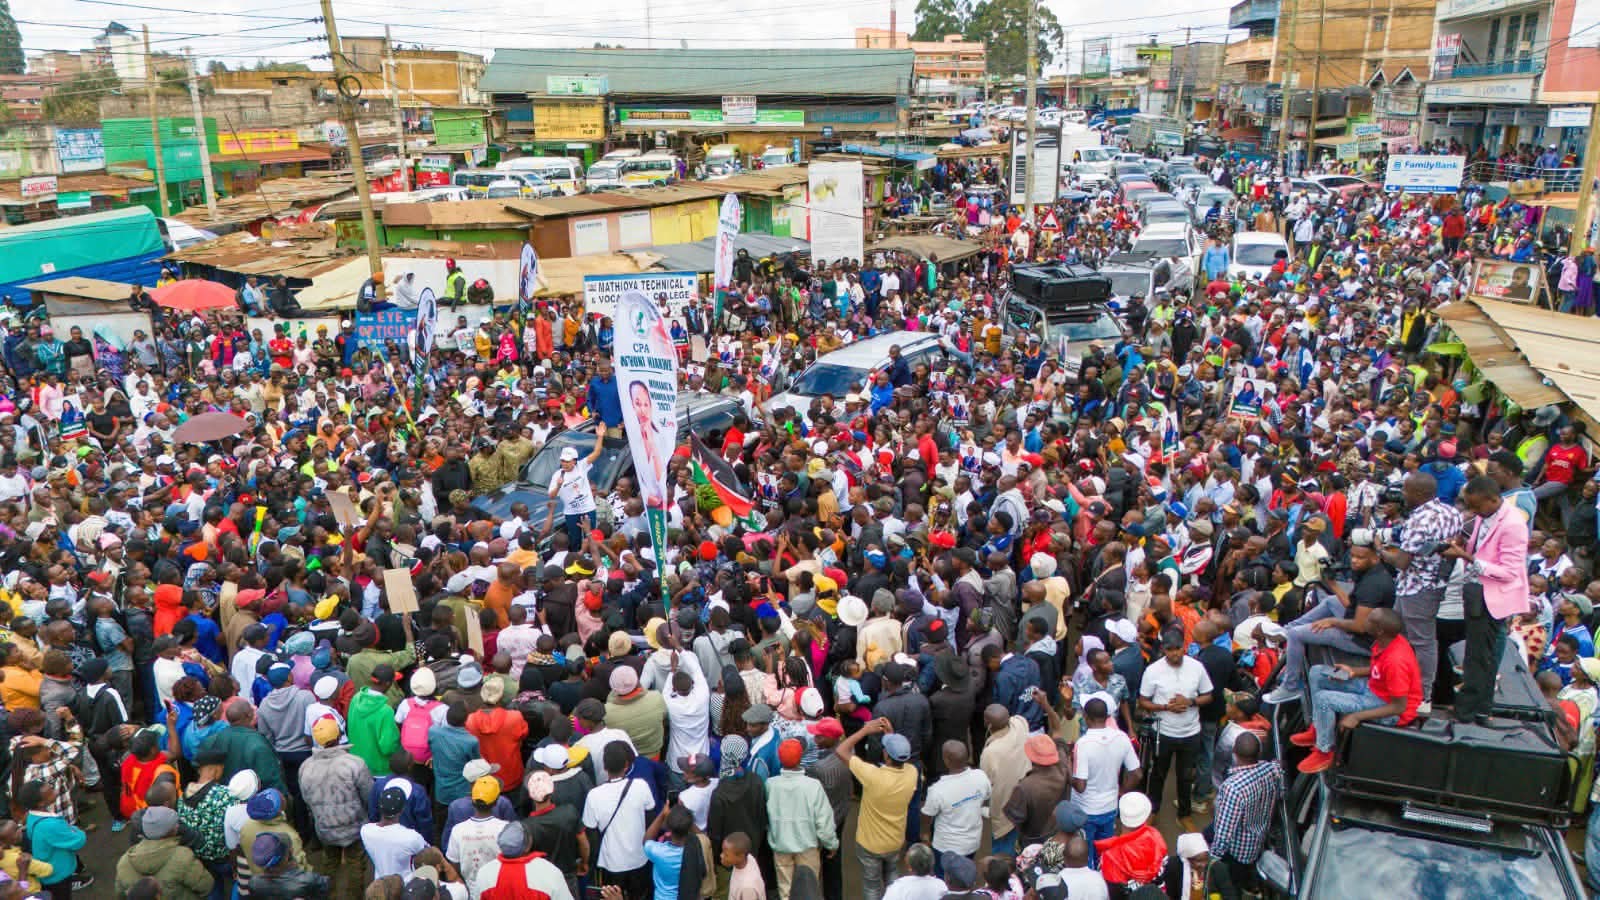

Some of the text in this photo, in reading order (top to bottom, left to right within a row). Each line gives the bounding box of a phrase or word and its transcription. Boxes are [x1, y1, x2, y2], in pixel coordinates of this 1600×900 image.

[641, 279, 684, 290] TECHNICAL
[377, 311, 403, 323] EYE
[633, 343, 650, 353] CPA
